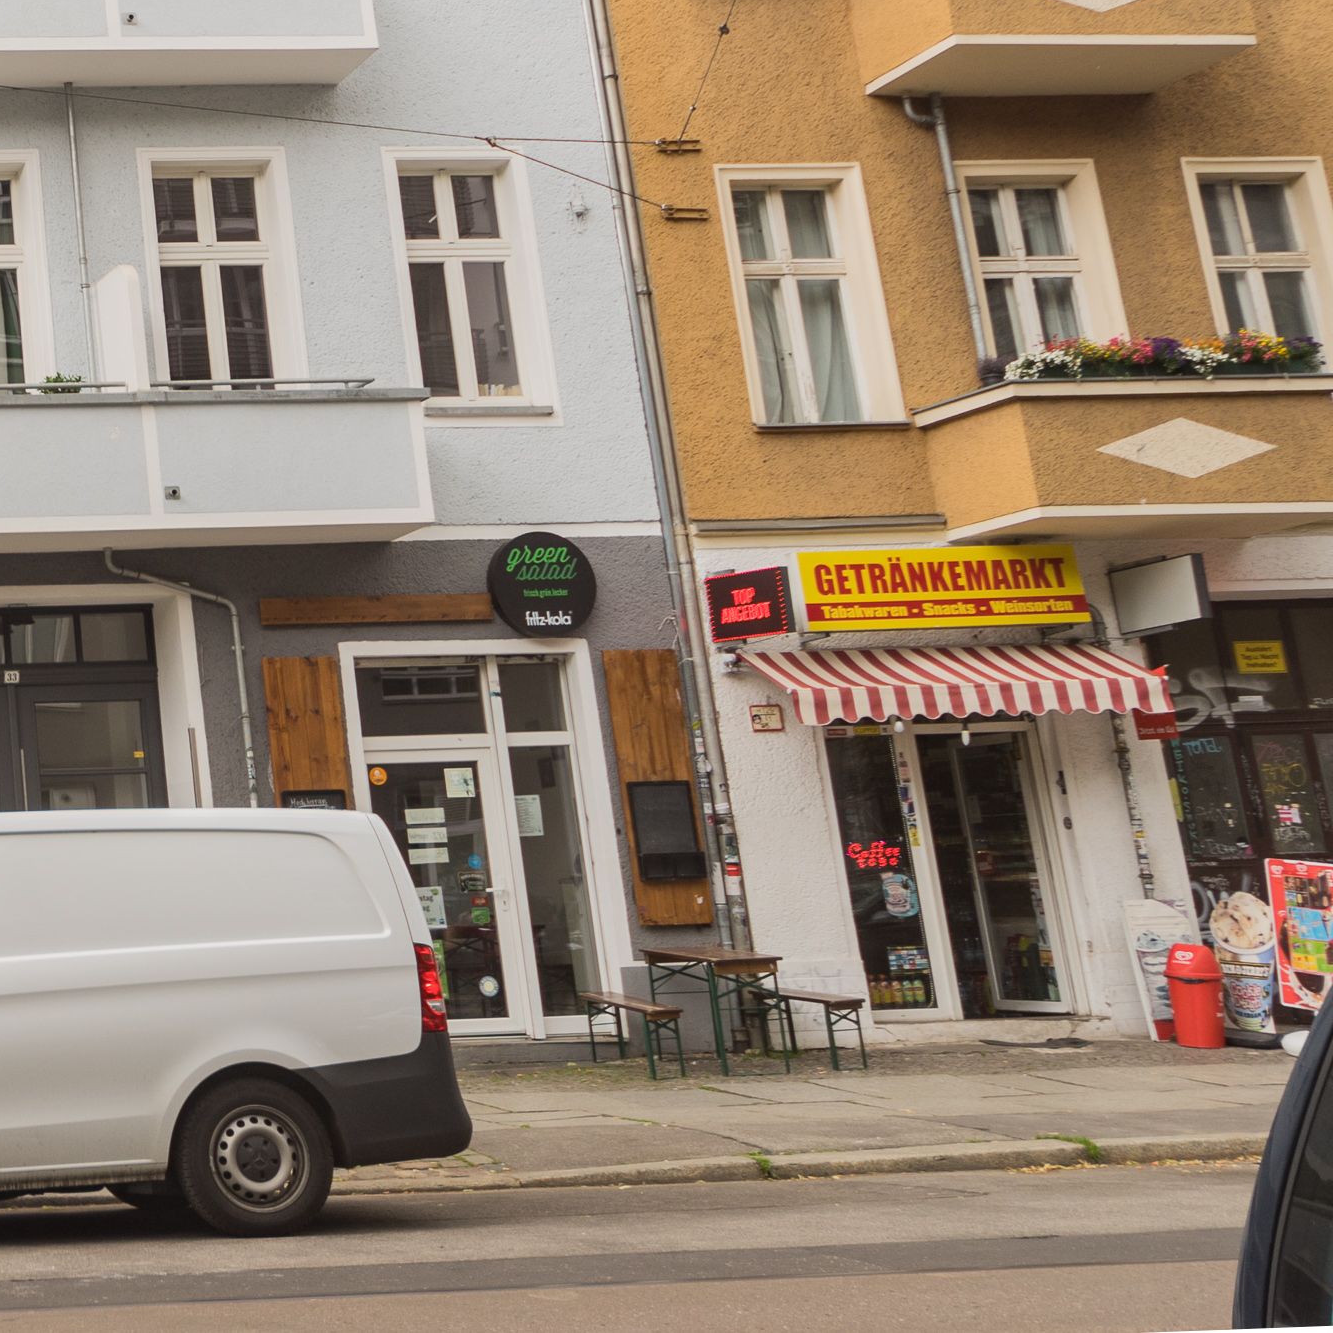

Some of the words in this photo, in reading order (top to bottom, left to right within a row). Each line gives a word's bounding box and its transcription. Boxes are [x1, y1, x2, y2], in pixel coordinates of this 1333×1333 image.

[506, 545, 571, 572] green
[516, 558, 578, 581] salad
[814, 556, 1066, 596] GETRÄNKEMARKT
[731, 587, 756, 605] TOP
[525, 611, 572, 627] fritz-kola
[721, 602, 771, 624] ANGEBOT
[821, 605, 907, 619] Tabakwaren
[923, 602, 976, 616] Snacks
[989, 599, 1074, 614] Weinsorten
[6, 672, 18, 682] 33
